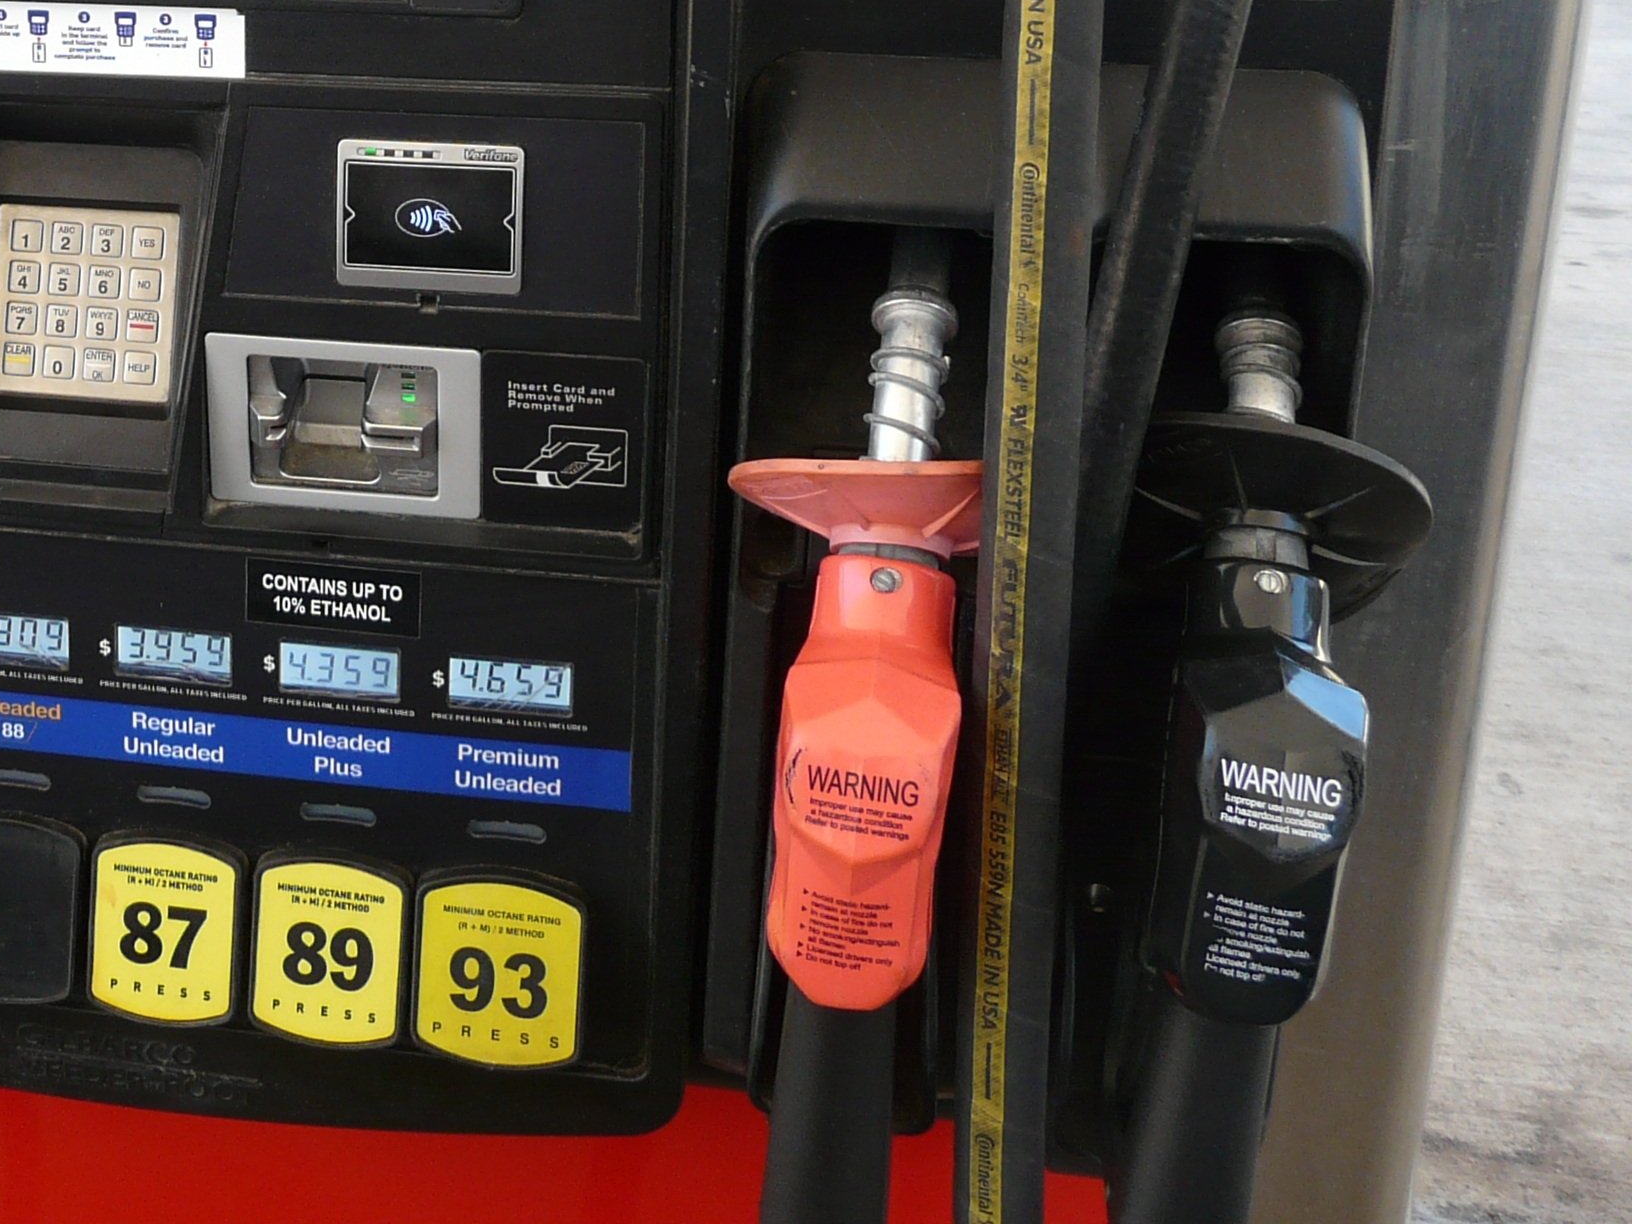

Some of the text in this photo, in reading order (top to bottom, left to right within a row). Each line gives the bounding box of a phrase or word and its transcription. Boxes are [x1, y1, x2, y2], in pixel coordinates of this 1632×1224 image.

[1024, 20, 1046, 64] USA
[464, 148, 518, 162] Verifone
[21, 234, 29, 248] 1
[61, 237, 70, 250] 2
[101, 239, 110, 253] 3
[139, 239, 155, 248] YES
[18, 276, 27, 288] 4
[58, 278, 68, 291] 5
[98, 281, 108, 294] 6
[138, 281, 151, 289] NO
[16, 317, 25, 330] 7
[128, 312, 157, 322] CANCEL
[55, 320, 65, 333] 8
[95, 323, 104, 336] 9
[5, 345, 32, 355] CLEAR
[86, 351, 112, 361] ENTER
[52, 361, 62, 374] 0
[128, 363, 150, 372] HELP
[507, 381, 616, 397] Insert Card and
[507, 390, 603, 405] Remove When
[507, 400, 574, 413] Prompted
[262, 573, 403, 601] CONTAINS UP TO
[272, 596, 391, 623] 10% ETHANOL
[1, 722, 25, 739] 88
[131, 711, 216, 736] Regular
[286, 727, 391, 755] Unleaded
[123, 736, 224, 764] Unleaded
[457, 743, 560, 770] Premium
[314, 756, 363, 778] Plus
[454, 770, 562, 797] Unleaded
[808, 764, 919, 807] WARNING
[1221, 758, 1342, 807] WARNING
[118, 901, 208, 969] 87
[282, 921, 374, 992] 89
[449, 946, 549, 1019] 93
